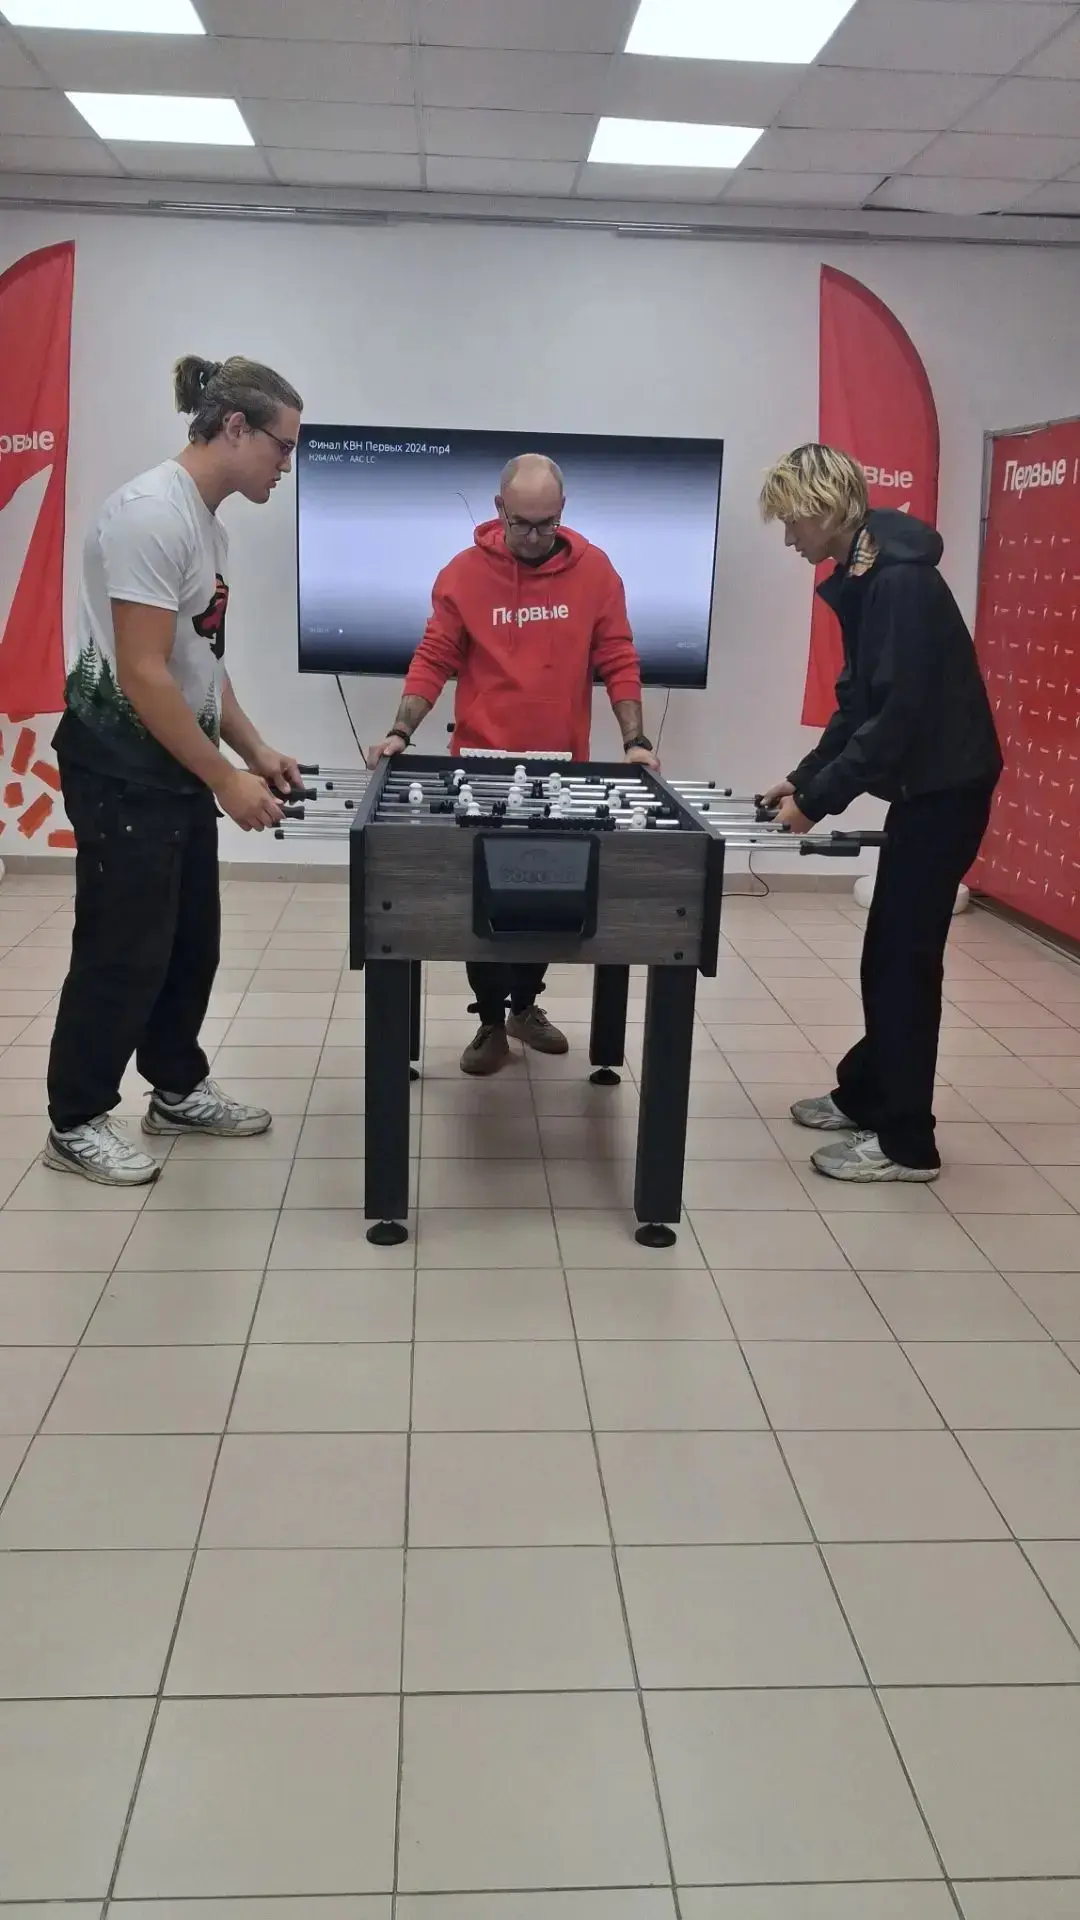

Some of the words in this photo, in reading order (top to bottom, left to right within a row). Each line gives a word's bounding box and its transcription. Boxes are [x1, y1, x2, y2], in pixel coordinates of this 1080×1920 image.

[308, 439, 341, 450] Финал
[343, 440, 363, 451] КВН
[365, 441, 403, 454] Первых
[405, 443, 450, 456] 2024.mp4
[859, 464, 914, 489] вые
[1002, 458, 1067, 499] Первые
